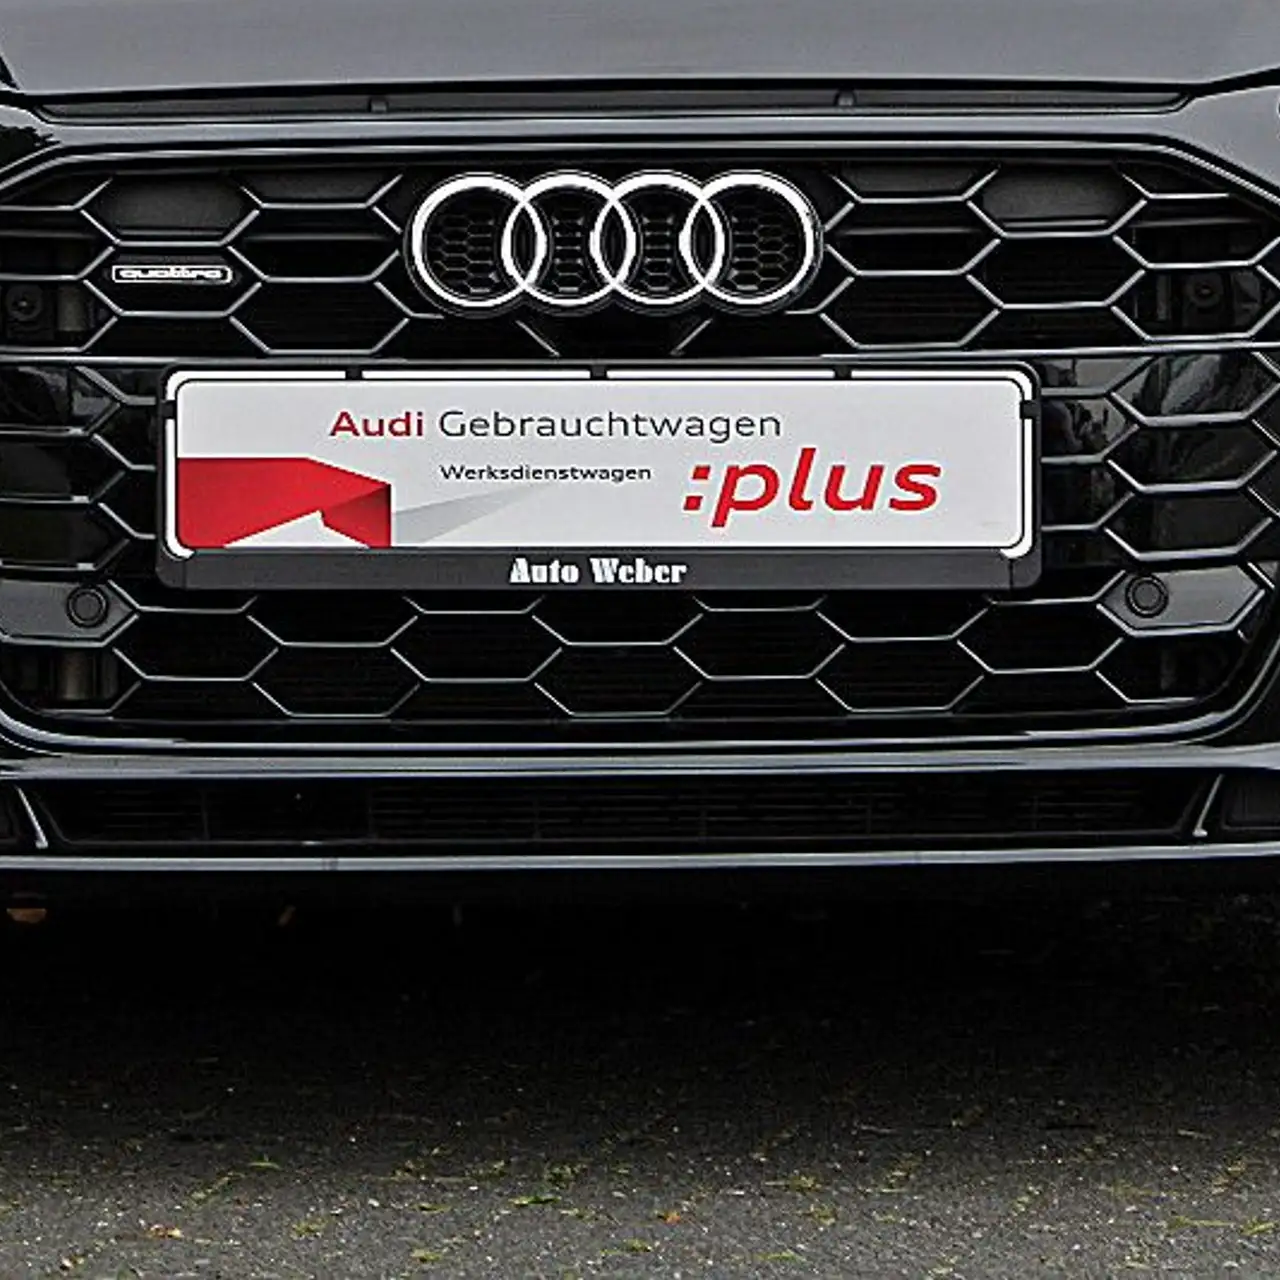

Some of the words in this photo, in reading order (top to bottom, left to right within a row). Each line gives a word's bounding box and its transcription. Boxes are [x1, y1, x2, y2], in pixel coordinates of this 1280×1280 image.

[329, 411, 424, 437] Audi
[438, 410, 781, 444] Gebrauchtwagen
[439, 464, 652, 483] Werksdienstwagen
[683, 447, 942, 528] :plus
[509, 557, 580, 583] Auto
[589, 557, 687, 583] Weber
